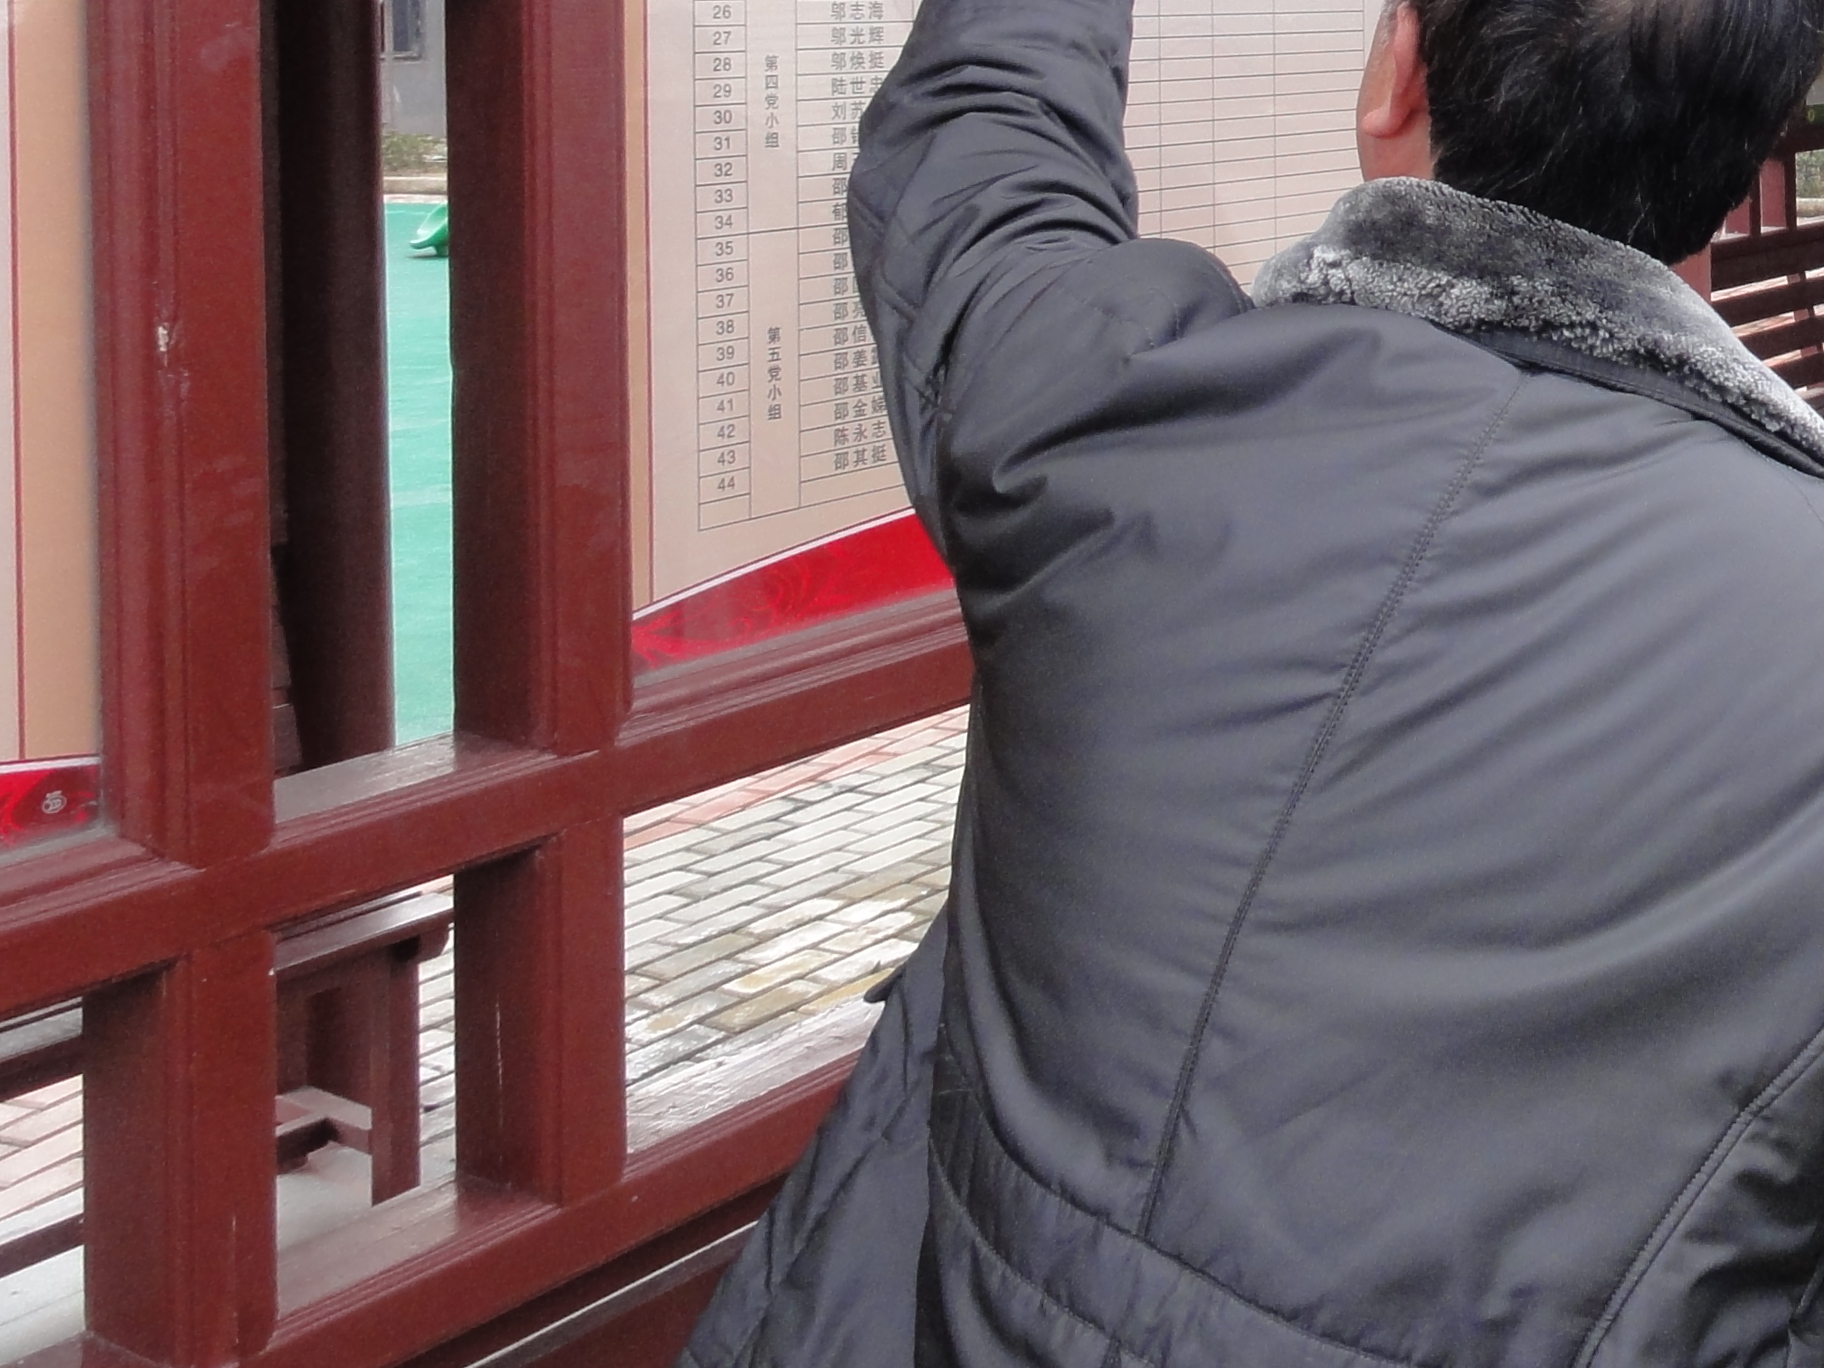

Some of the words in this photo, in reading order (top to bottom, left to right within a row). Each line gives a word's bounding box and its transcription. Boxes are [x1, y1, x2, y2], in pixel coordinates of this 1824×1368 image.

[712, 4, 732, 20] 26
[712, 30, 732, 46] 27
[712, 56, 732, 73] 28
[712, 83, 732, 99] 29
[764, 54, 780, 149] 第四党小组
[713, 109, 733, 125] 30
[713, 136, 731, 151] 31
[714, 161, 733, 178] 32
[714, 188, 734, 204] 33
[714, 214, 734, 230] 34
[715, 240, 734, 257] 35
[715, 266, 735, 283] 36
[715, 292, 735, 309] 37
[715, 319, 735, 336] 38
[833, 324, 874, 346] 邵信
[716, 345, 735, 362] 39
[716, 371, 736, 387] 40
[767, 326, 783, 421] 第五党小组
[716, 397, 734, 413] 41
[716, 423, 736, 439] 42
[834, 420, 887, 447] 陈永志
[717, 449, 736, 466] 43
[717, 476, 736, 492] 44
